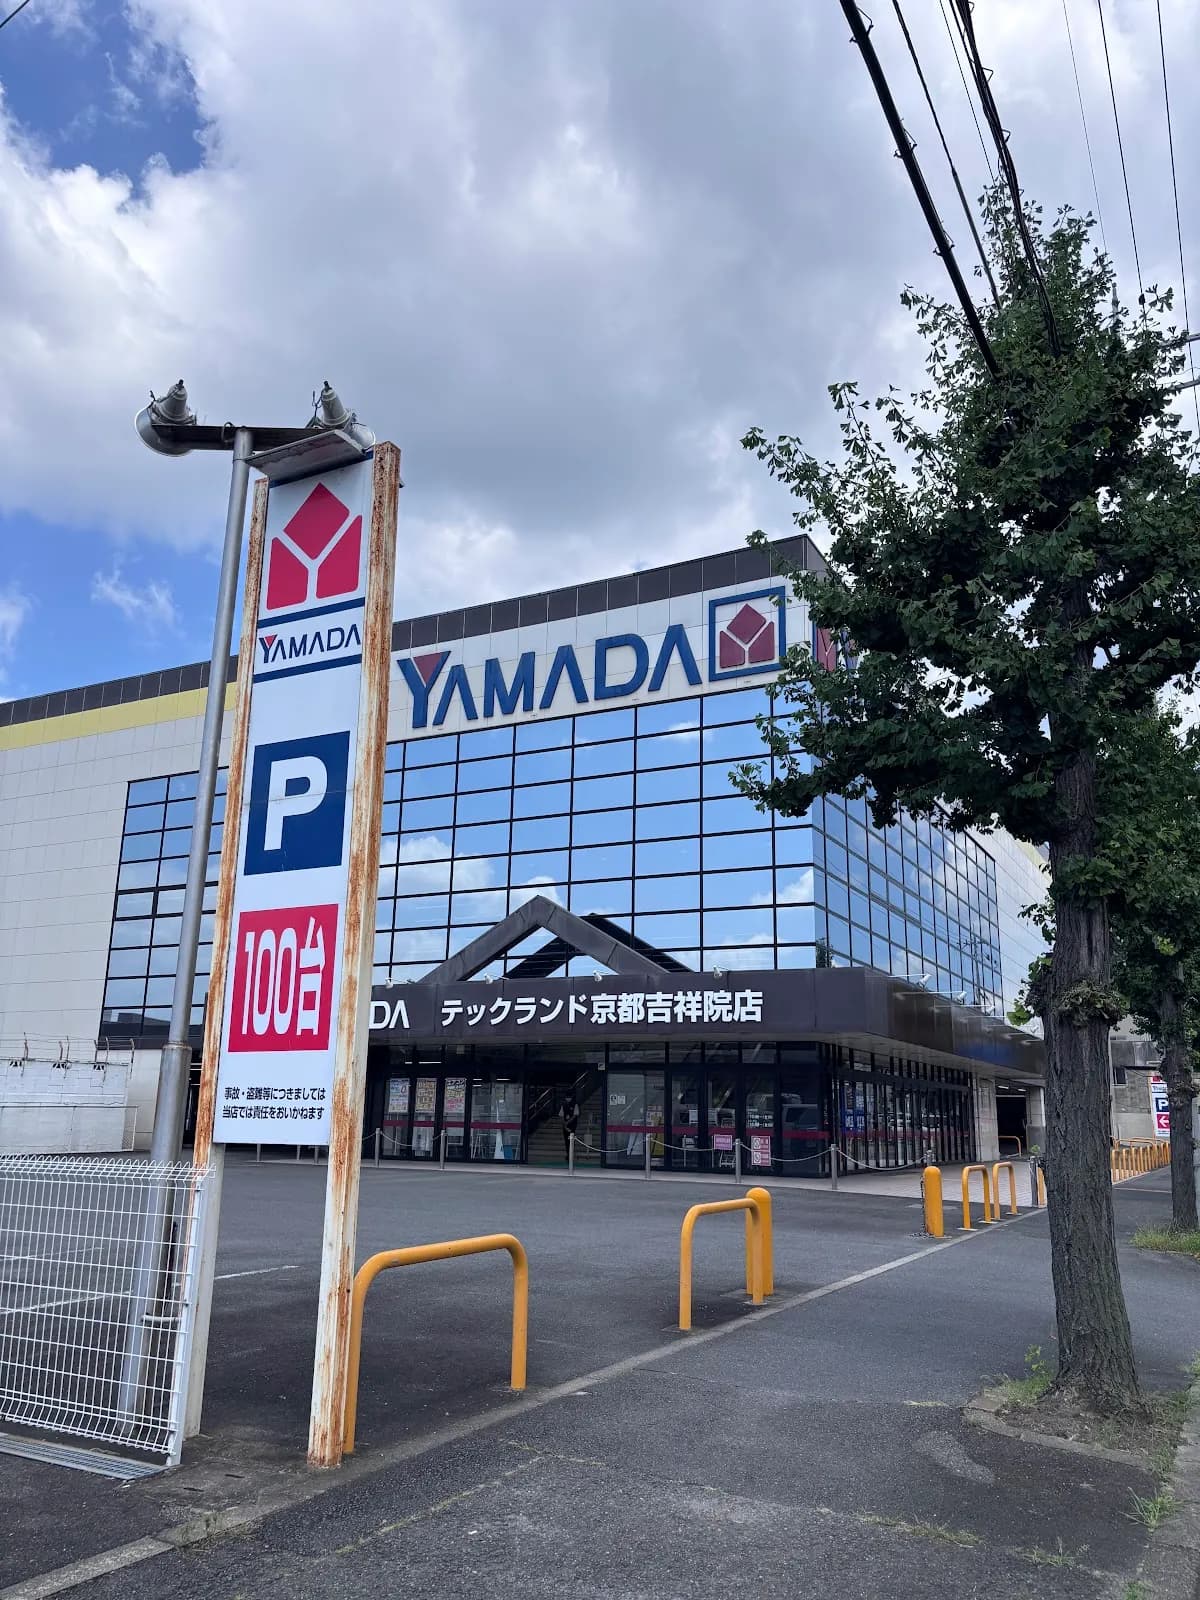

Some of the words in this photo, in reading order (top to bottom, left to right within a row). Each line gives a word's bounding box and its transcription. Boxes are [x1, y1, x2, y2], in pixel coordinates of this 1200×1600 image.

[259, 623, 361, 663] YAMADA
[396, 623, 702, 729] YAMADA
[264, 755, 328, 851] P
[242, 916, 325, 1035] 100台
[440, 989, 763, 1027] テックランド京都吉祥院店
[222, 1105, 325, 1120] 当店では責任をおいかねます
[224, 1086, 326, 1101] 事故・盗難等につきましては
[1158, 1098, 1169, 1110] P
